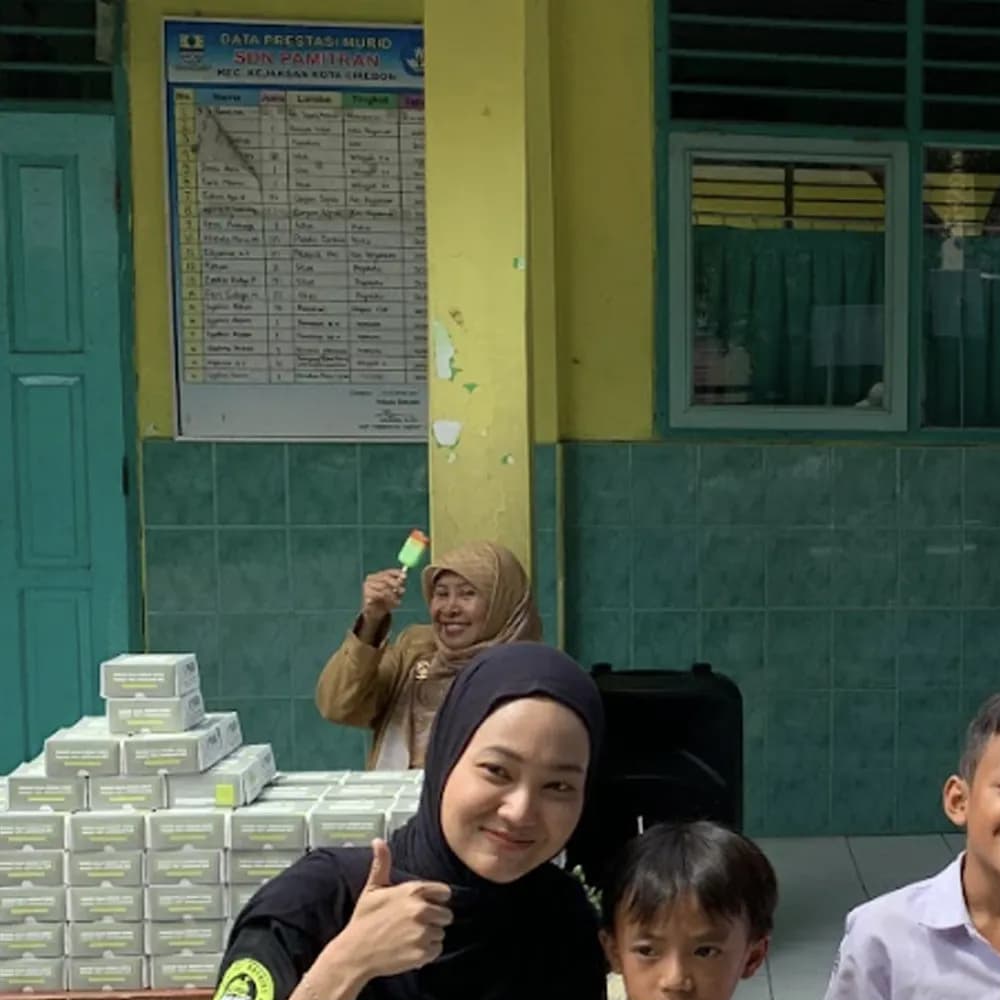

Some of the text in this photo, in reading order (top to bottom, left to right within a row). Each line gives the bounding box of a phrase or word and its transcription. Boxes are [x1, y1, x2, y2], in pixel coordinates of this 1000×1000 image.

[220, 33, 393, 49] DATA PRESTASI MURID
[233, 50, 380, 67] SDN PAMITRAN
